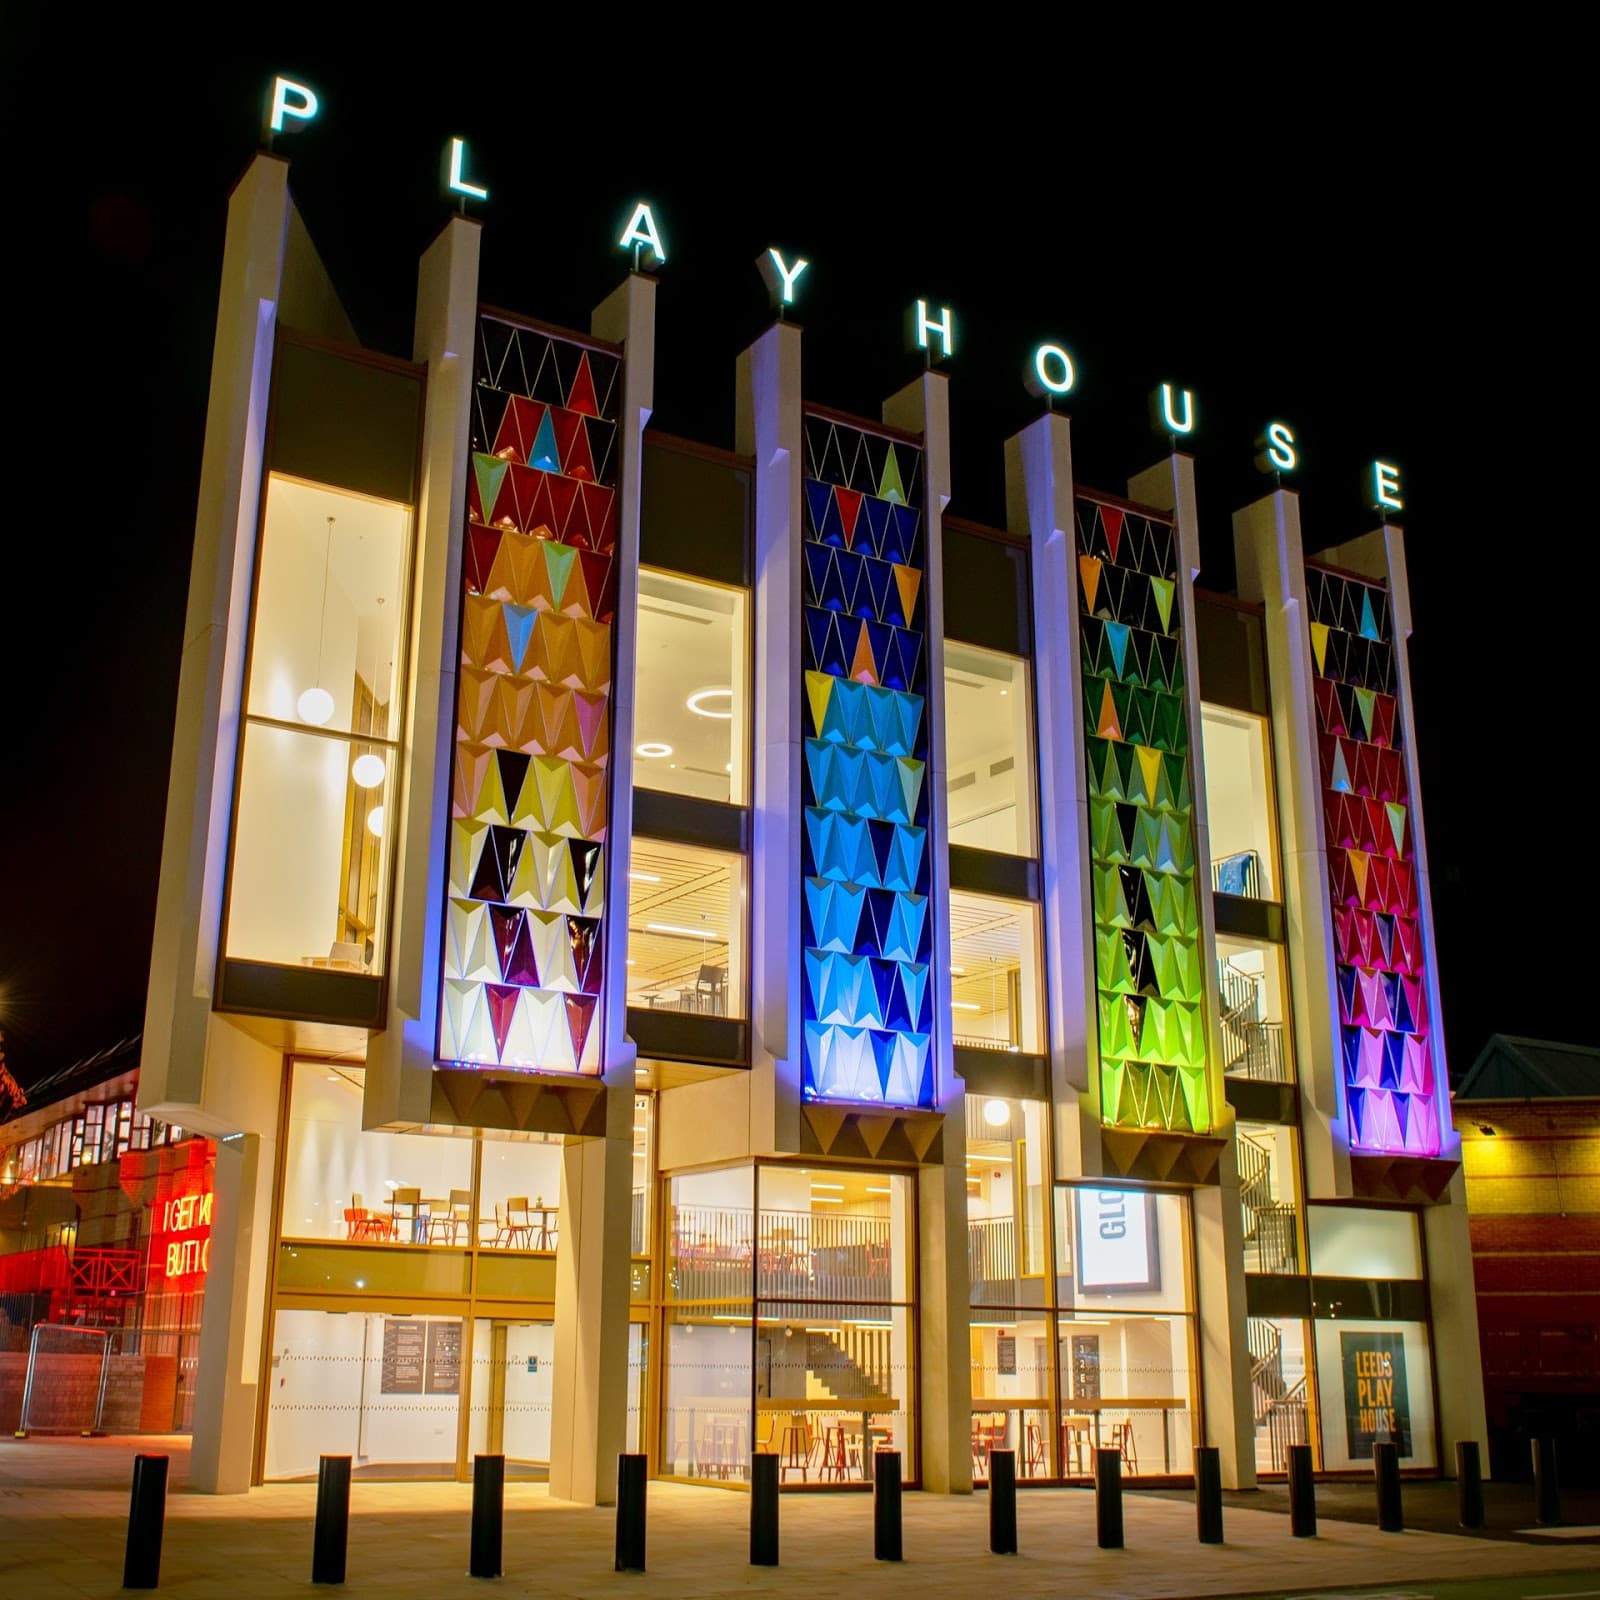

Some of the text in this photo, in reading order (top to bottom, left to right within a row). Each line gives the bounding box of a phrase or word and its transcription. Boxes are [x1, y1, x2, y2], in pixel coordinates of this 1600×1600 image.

[270, 76, 1402, 509] PLAYHOUSE
[163, 1201, 169, 1232] I
[170, 1195, 199, 1232] GET
[1356, 1351, 1393, 1378] LEEDS
[1358, 1378, 1393, 1407] PLAY
[1360, 1407, 1396, 1433] HOUSE
